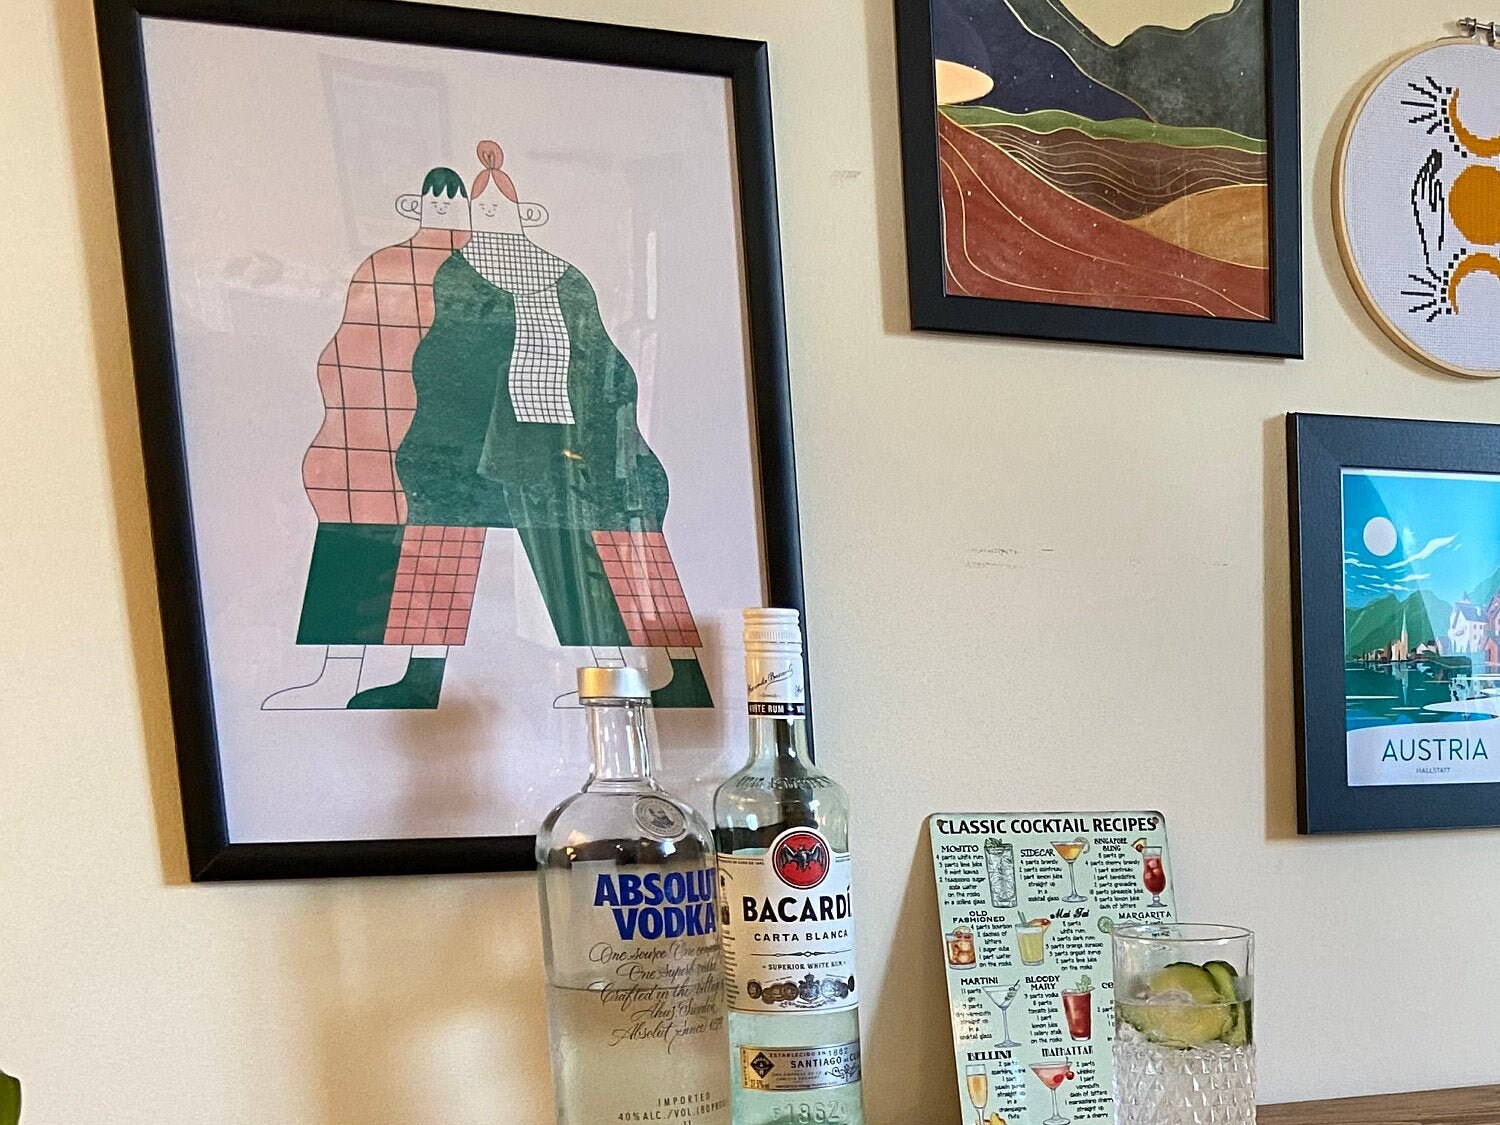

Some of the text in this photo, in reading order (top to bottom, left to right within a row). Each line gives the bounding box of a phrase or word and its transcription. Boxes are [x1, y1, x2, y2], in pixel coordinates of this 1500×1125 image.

[768, 703, 785, 713] RUM
[1382, 738, 1488, 762] AUSTRIA
[938, 818, 1157, 834] CLASSIC COCKTAIL RECIPES
[941, 845, 979, 853] MOJITO
[1020, 848, 1055, 857] SIDECAR
[594, 867, 717, 906] ABSOLUT
[743, 884, 851, 922] BACARDÍ
[1050, 907, 1089, 919] Mai Tai
[1118, 911, 1172, 920] MARGARITA
[612, 902, 716, 940] VODKA
[754, 929, 848, 942] CARTA BLANCA
[589, 942, 626, 964] One
[616, 962, 656, 981] One
[961, 977, 998, 985] MARTINI
[1025, 975, 1060, 983] BLOODY
[1031, 983, 1056, 991] MARY
[656, 989, 669, 1000] in
[608, 1021, 671, 1046] Absolut
[769, 1051, 815, 1059] ESTABLECIDO
[828, 1047, 849, 1057] 1862
[967, 1050, 1012, 1061] BELLINI
[1042, 1046, 1093, 1057] MANHATTAN
[791, 1056, 842, 1068] SANTIAGO
[658, 1091, 711, 1107] IMPORTED
